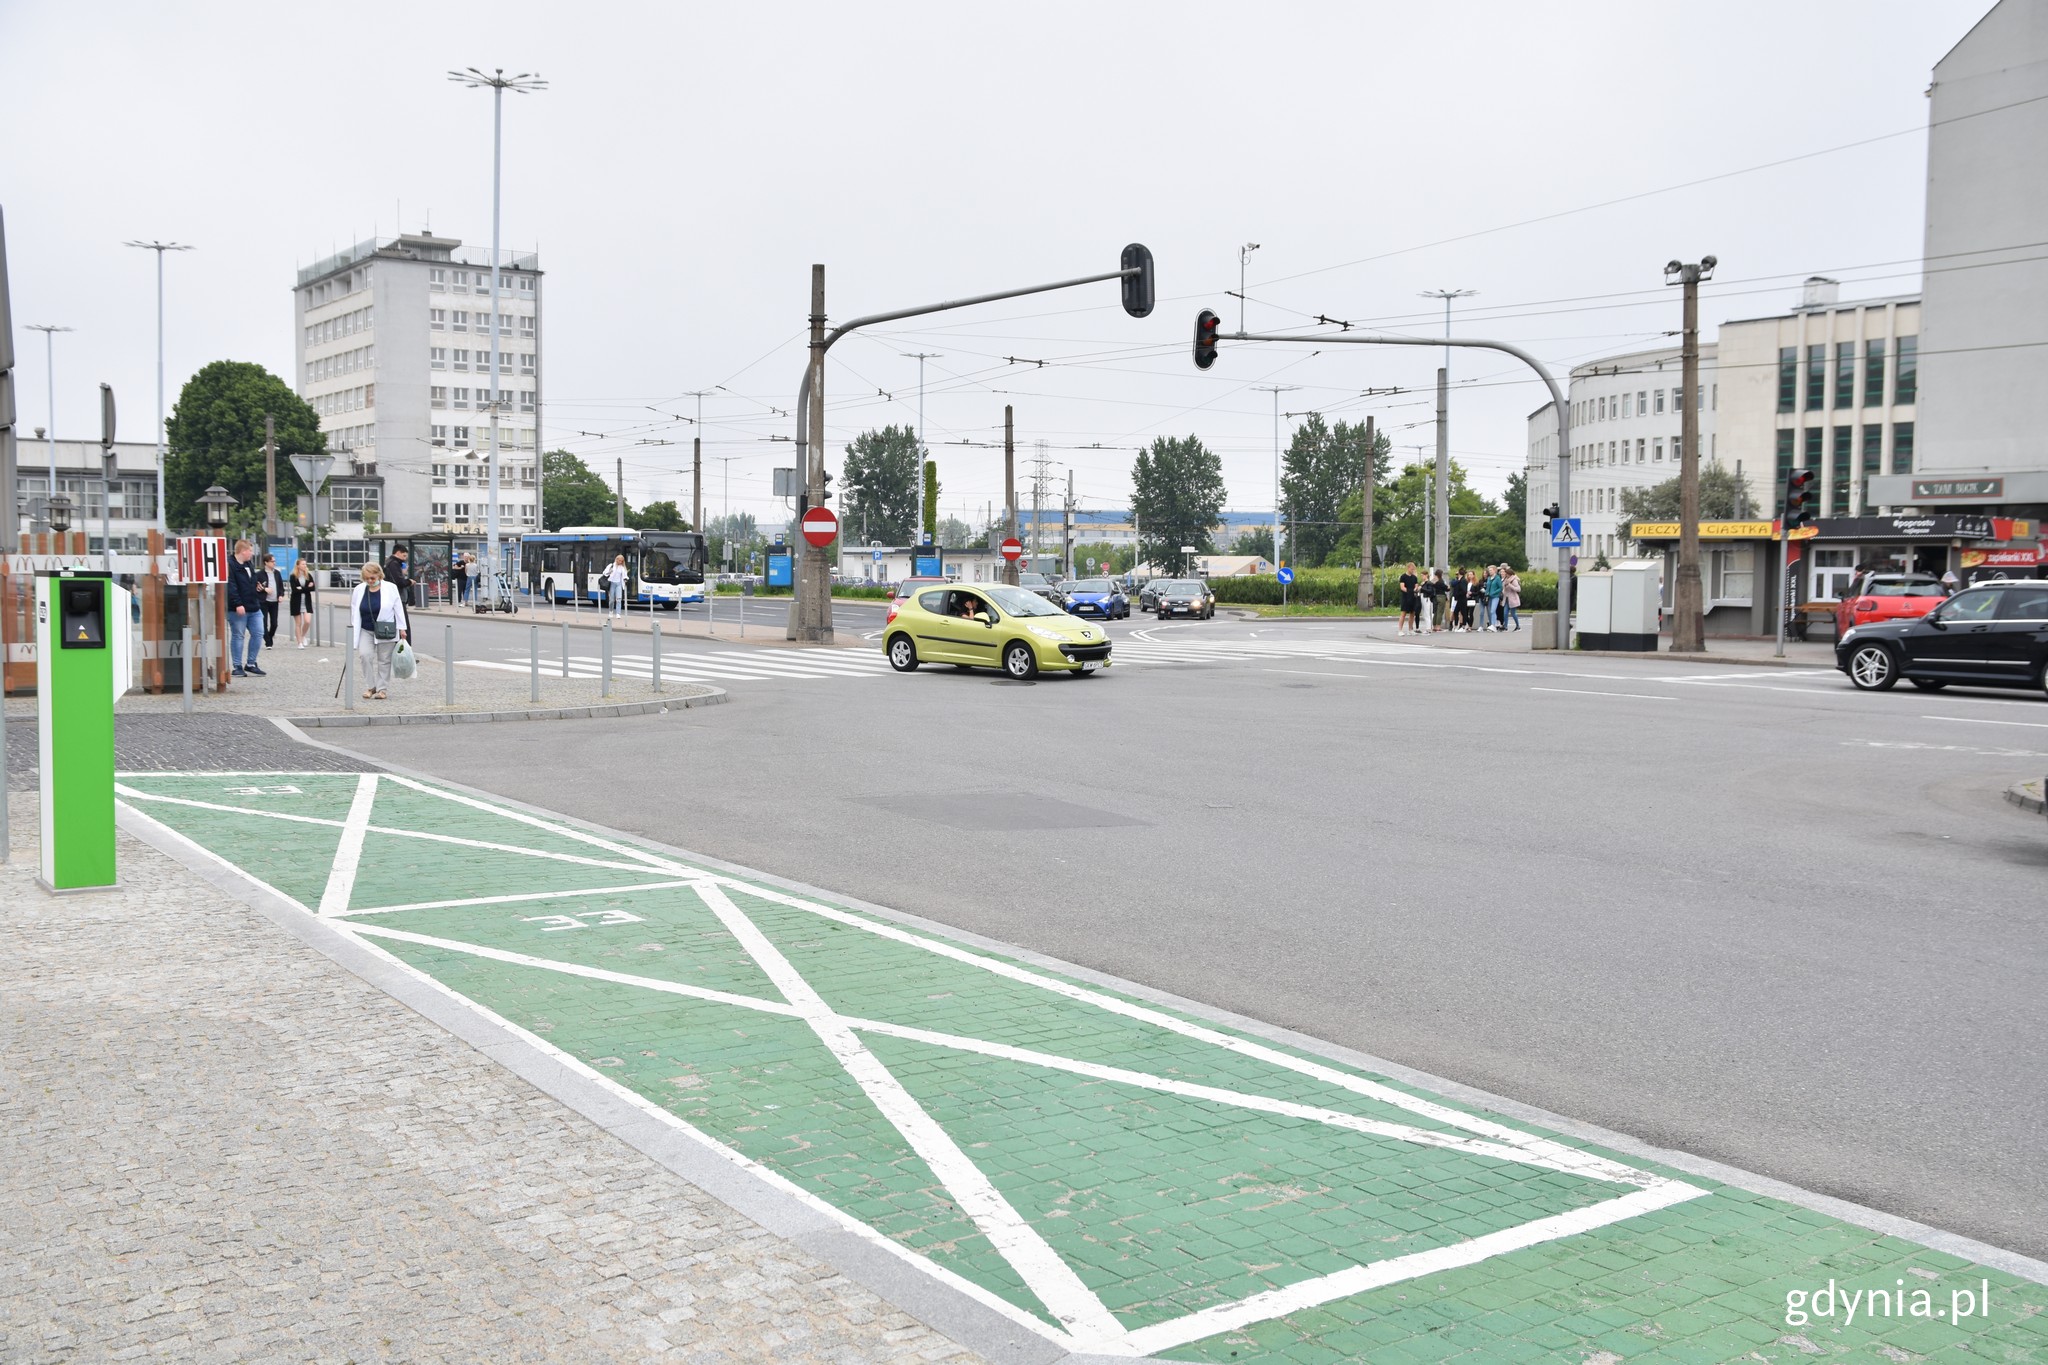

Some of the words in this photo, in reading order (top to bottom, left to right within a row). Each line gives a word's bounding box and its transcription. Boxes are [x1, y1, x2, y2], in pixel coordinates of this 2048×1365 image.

[443, 522, 488, 534] POCZT
[1635, 525, 1700, 534] PIECZY
[1706, 524, 1768, 534] CIASTKA
[181, 543, 189, 578] H
[203, 543, 217, 577] H
[520, 910, 647, 931] 33
